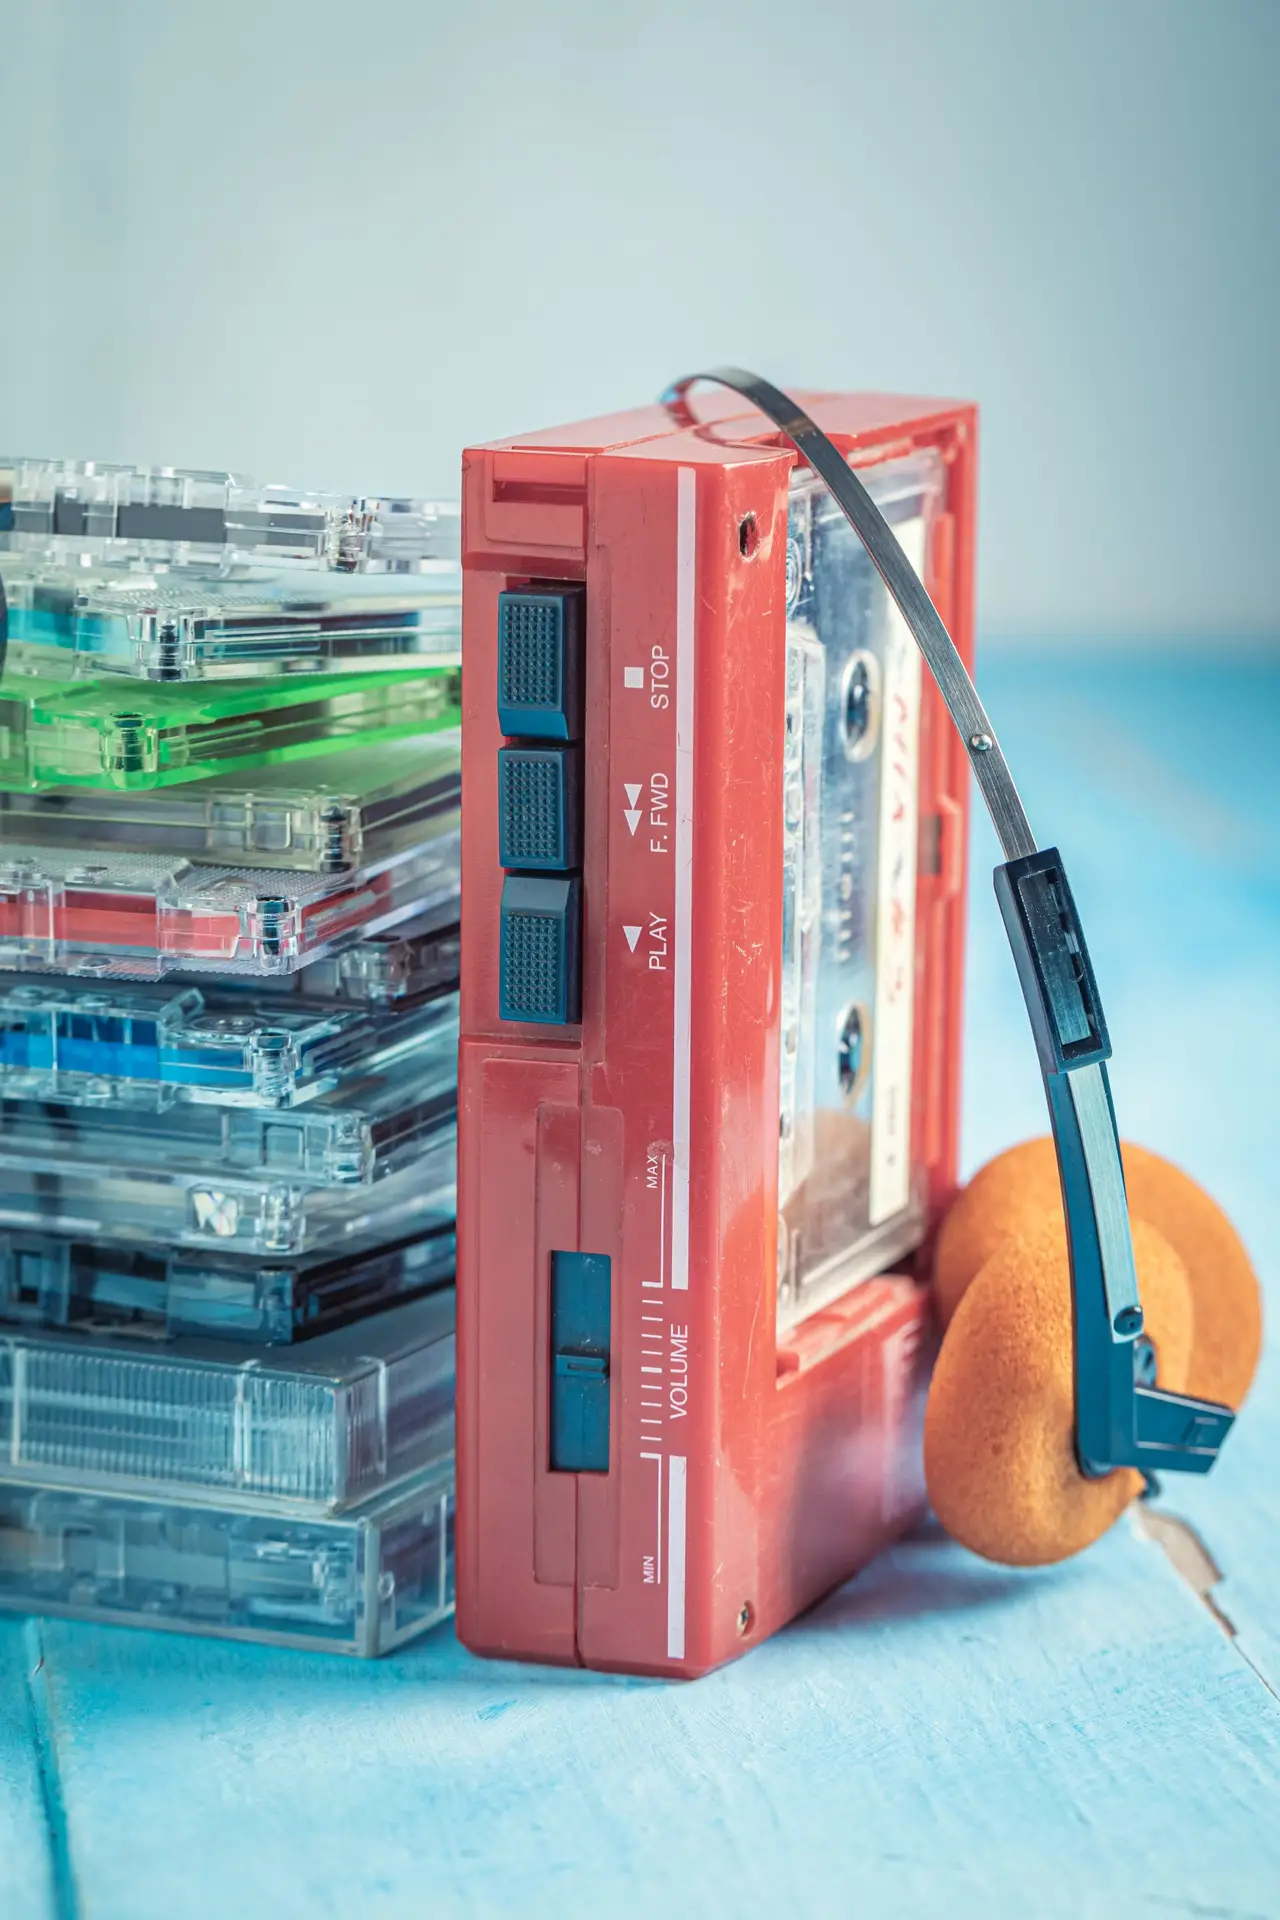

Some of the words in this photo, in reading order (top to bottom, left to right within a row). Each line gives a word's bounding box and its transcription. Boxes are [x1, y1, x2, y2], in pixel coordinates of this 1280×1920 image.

[650, 645, 670, 710] STOP
[650, 772, 669, 827] FWD
[648, 911, 668, 971] PLAY
[645, 1154, 659, 1189] MAX
[668, 1323, 689, 1420] VOLUME
[642, 1555, 655, 1585] MIN
